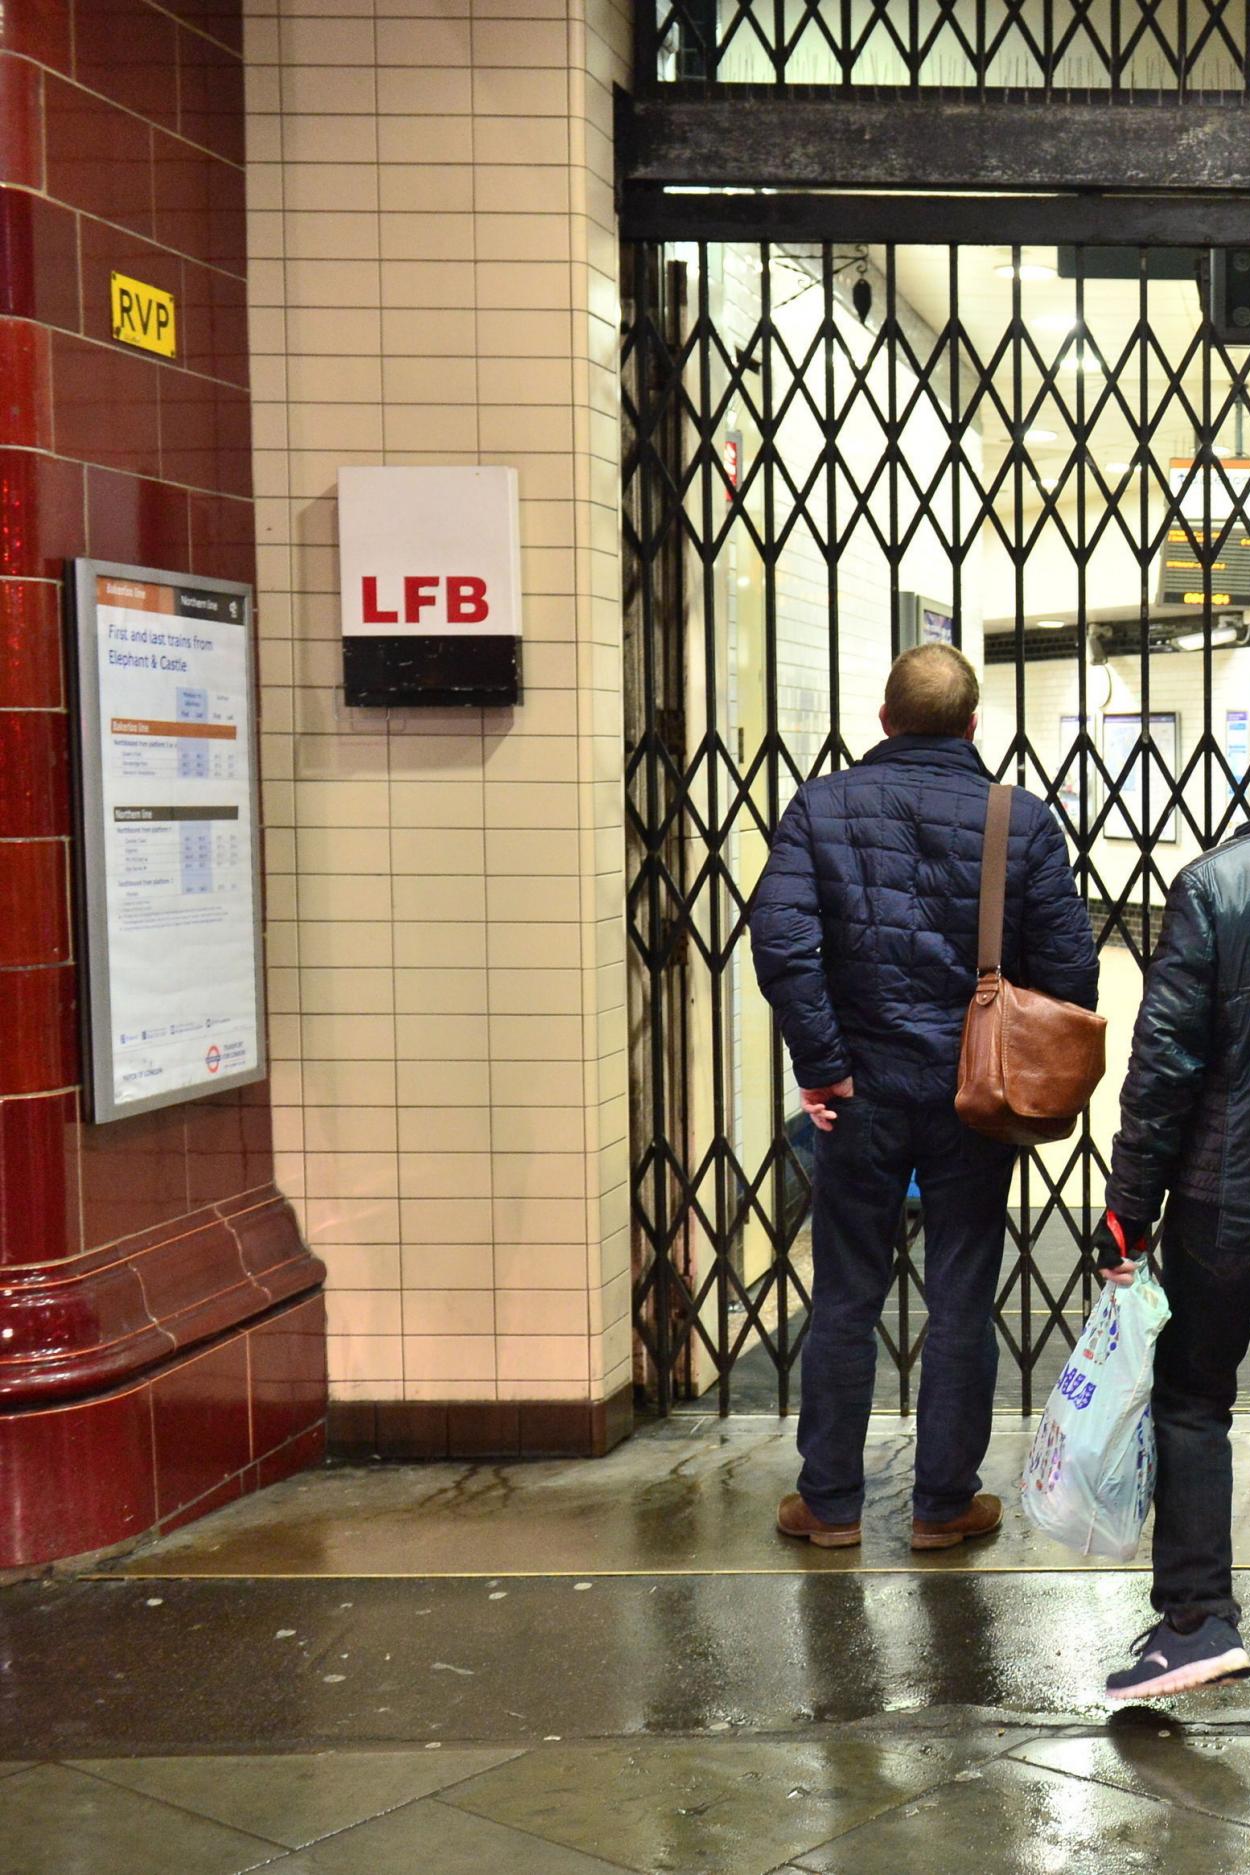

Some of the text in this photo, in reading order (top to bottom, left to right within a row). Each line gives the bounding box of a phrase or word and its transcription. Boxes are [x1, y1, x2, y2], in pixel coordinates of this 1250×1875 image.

[119, 288, 170, 341] RVP
[361, 576, 490, 624] LFB
[108, 624, 214, 652] First and last trains from
[109, 649, 188, 673] Elephant & Castle
